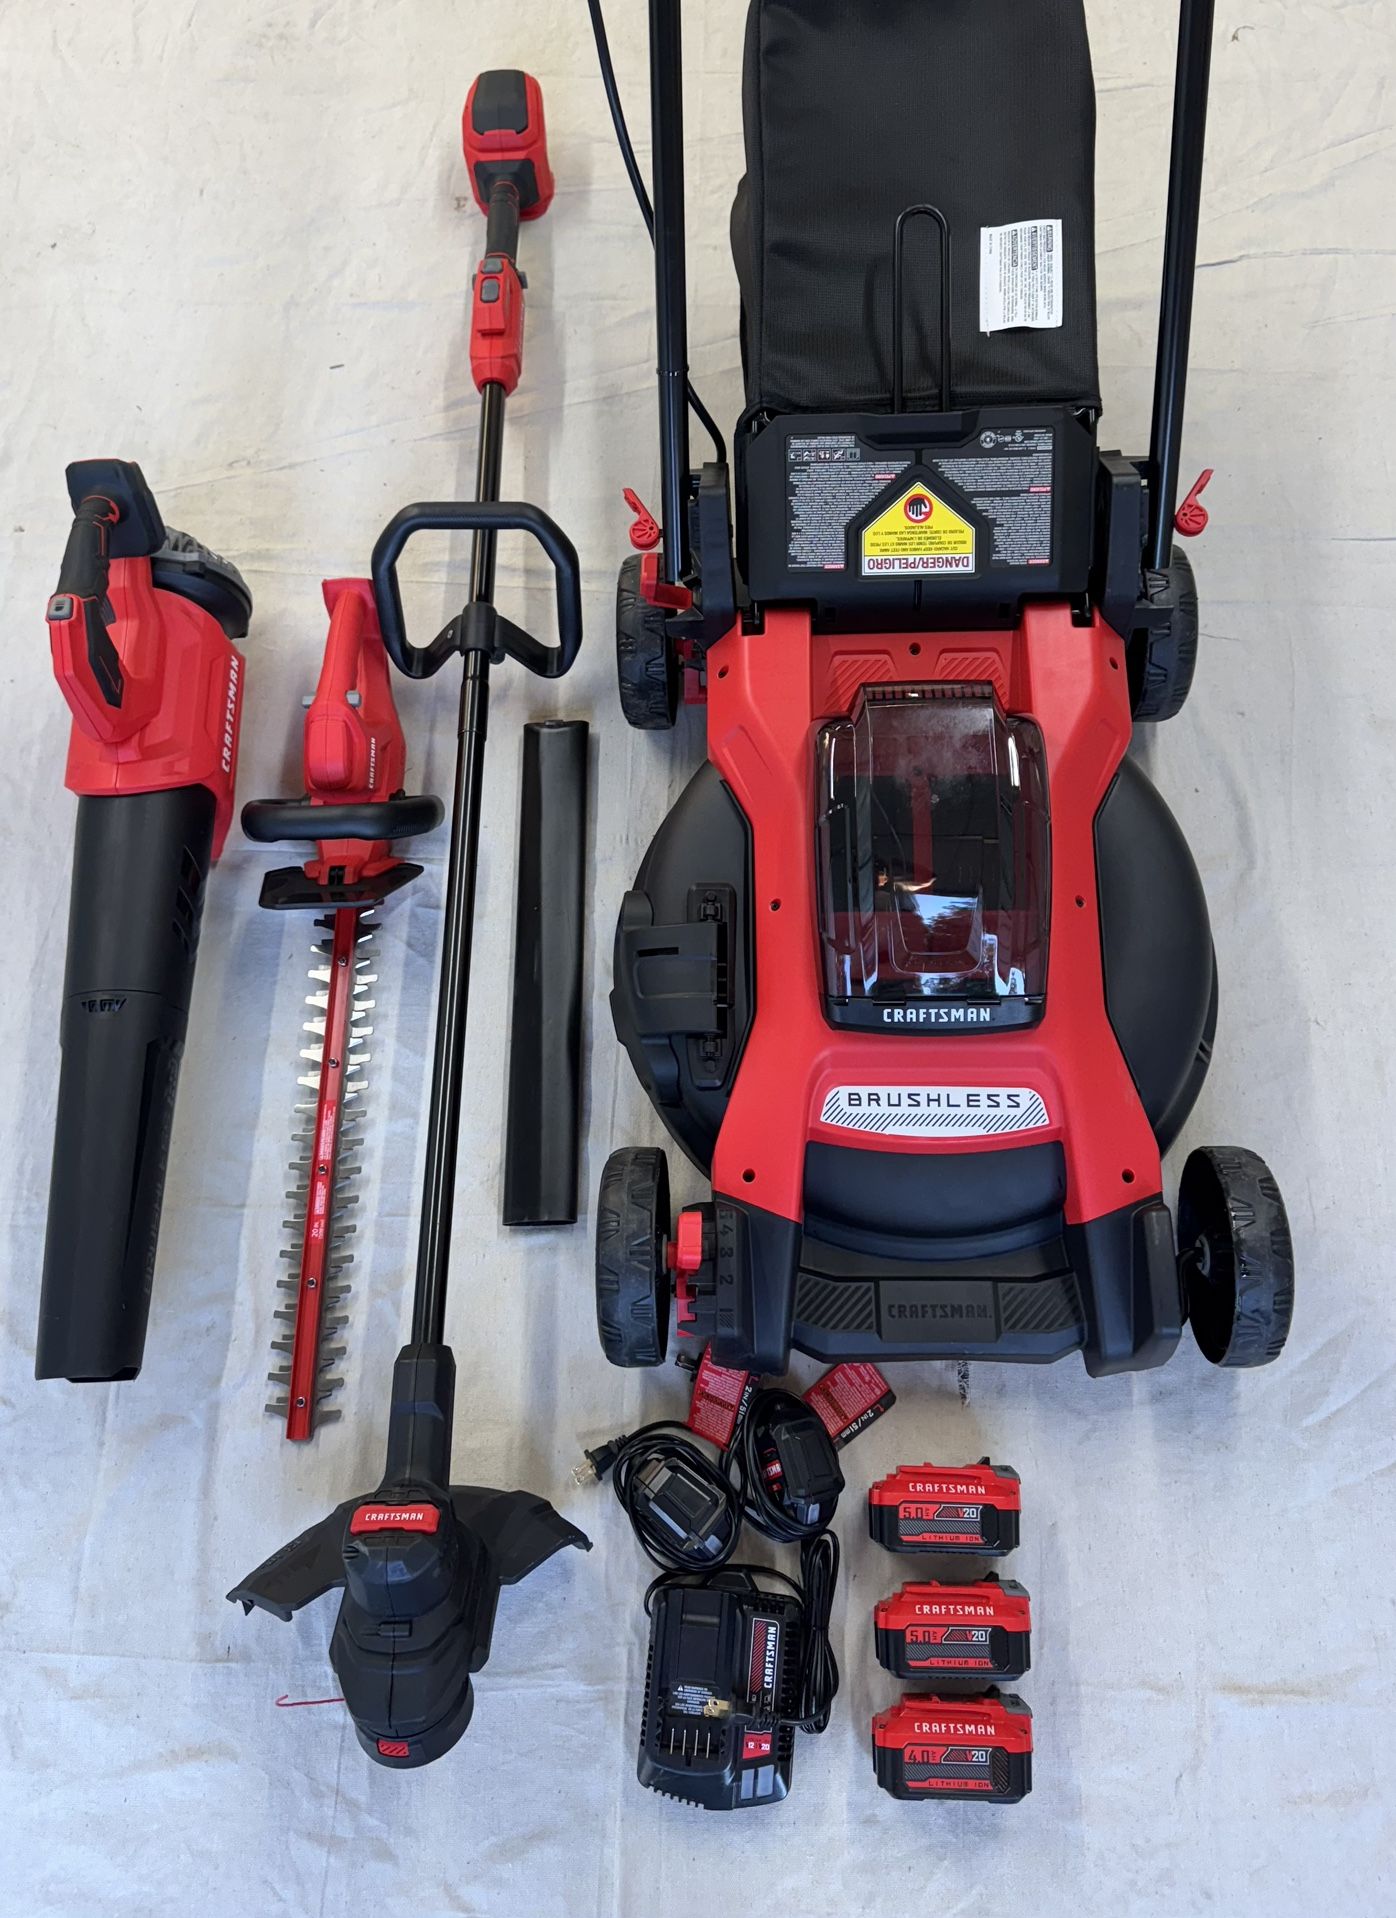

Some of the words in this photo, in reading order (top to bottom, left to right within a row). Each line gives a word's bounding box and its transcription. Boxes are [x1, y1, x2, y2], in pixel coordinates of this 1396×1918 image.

[868, 556, 970, 570] DANGER/PELIGRO
[220, 656, 240, 773] CRAFTSMAN
[368, 737, 376, 789] CRAFTSMAN
[883, 1008, 990, 1022] CRAFTSMAN
[848, 1092, 1020, 1108] BRUSHLESS
[887, 1304, 989, 1320] CRAFTSMAN
[909, 1483, 986, 1494] CRAFTSMAN
[365, 1512, 424, 1521] CRAFTSMAN
[916, 1605, 994, 1616] CRAFTSMAN
[764, 1626, 776, 1689] CRAFTSMAN
[914, 1723, 995, 1736] CRAFTSMAN
